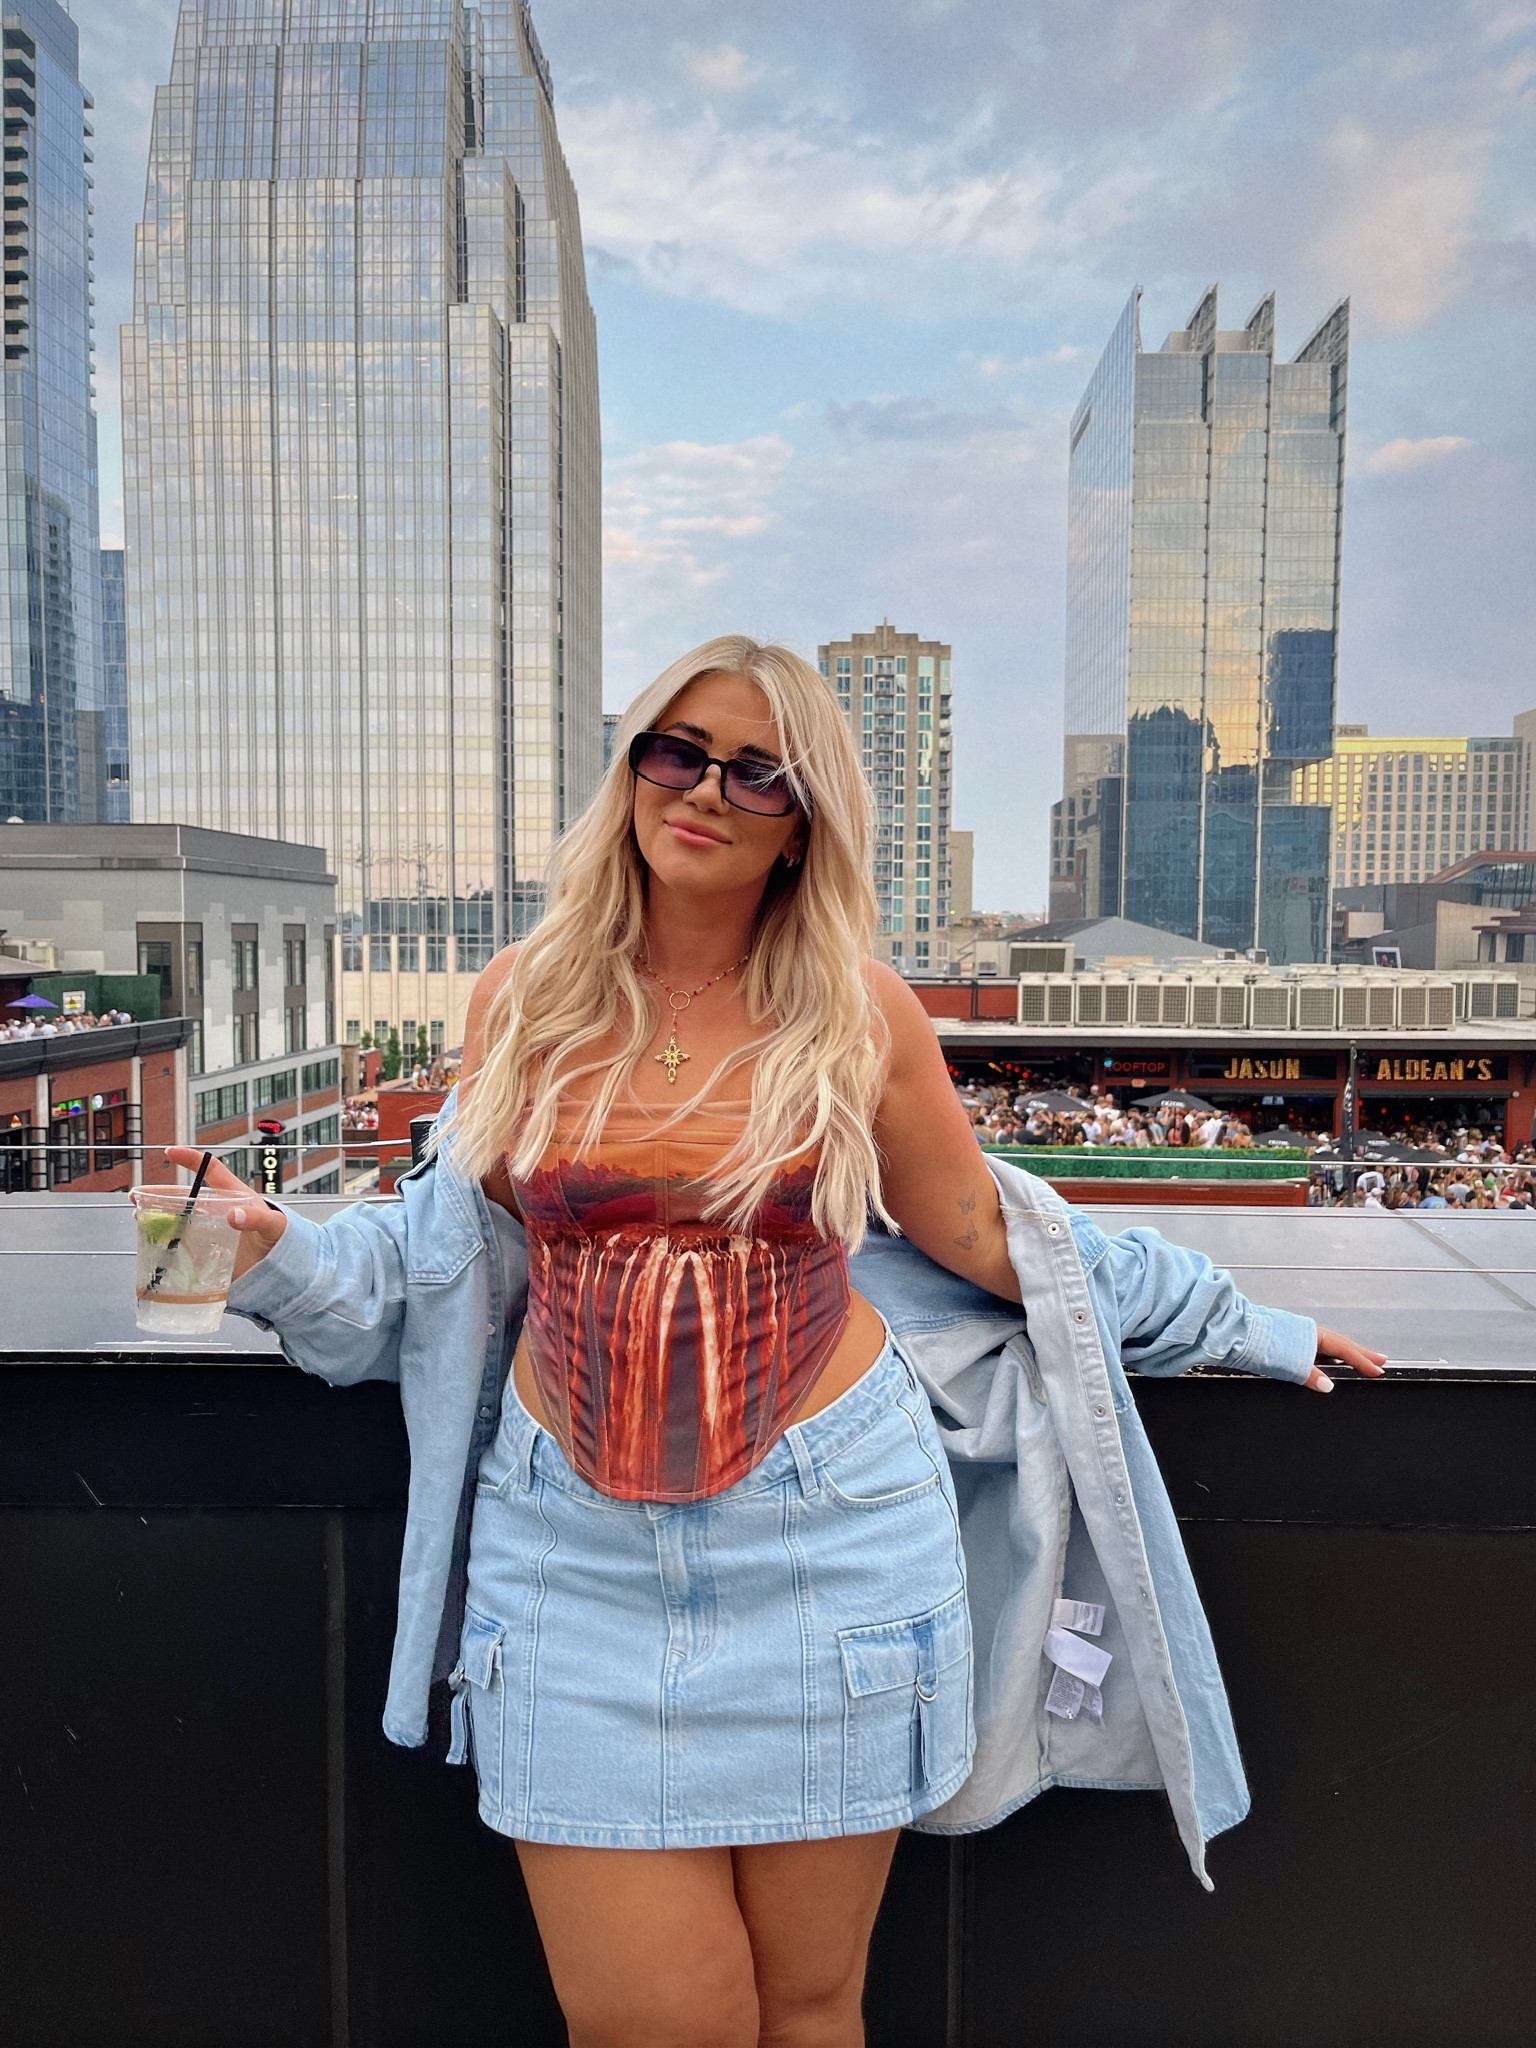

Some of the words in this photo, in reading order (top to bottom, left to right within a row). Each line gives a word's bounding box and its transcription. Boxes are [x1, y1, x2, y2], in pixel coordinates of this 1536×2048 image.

[1224, 1058, 1300, 1079] JASON
[1377, 1058, 1492, 1081] ALDEAN'S
[263, 1144, 278, 1193] HOTE
